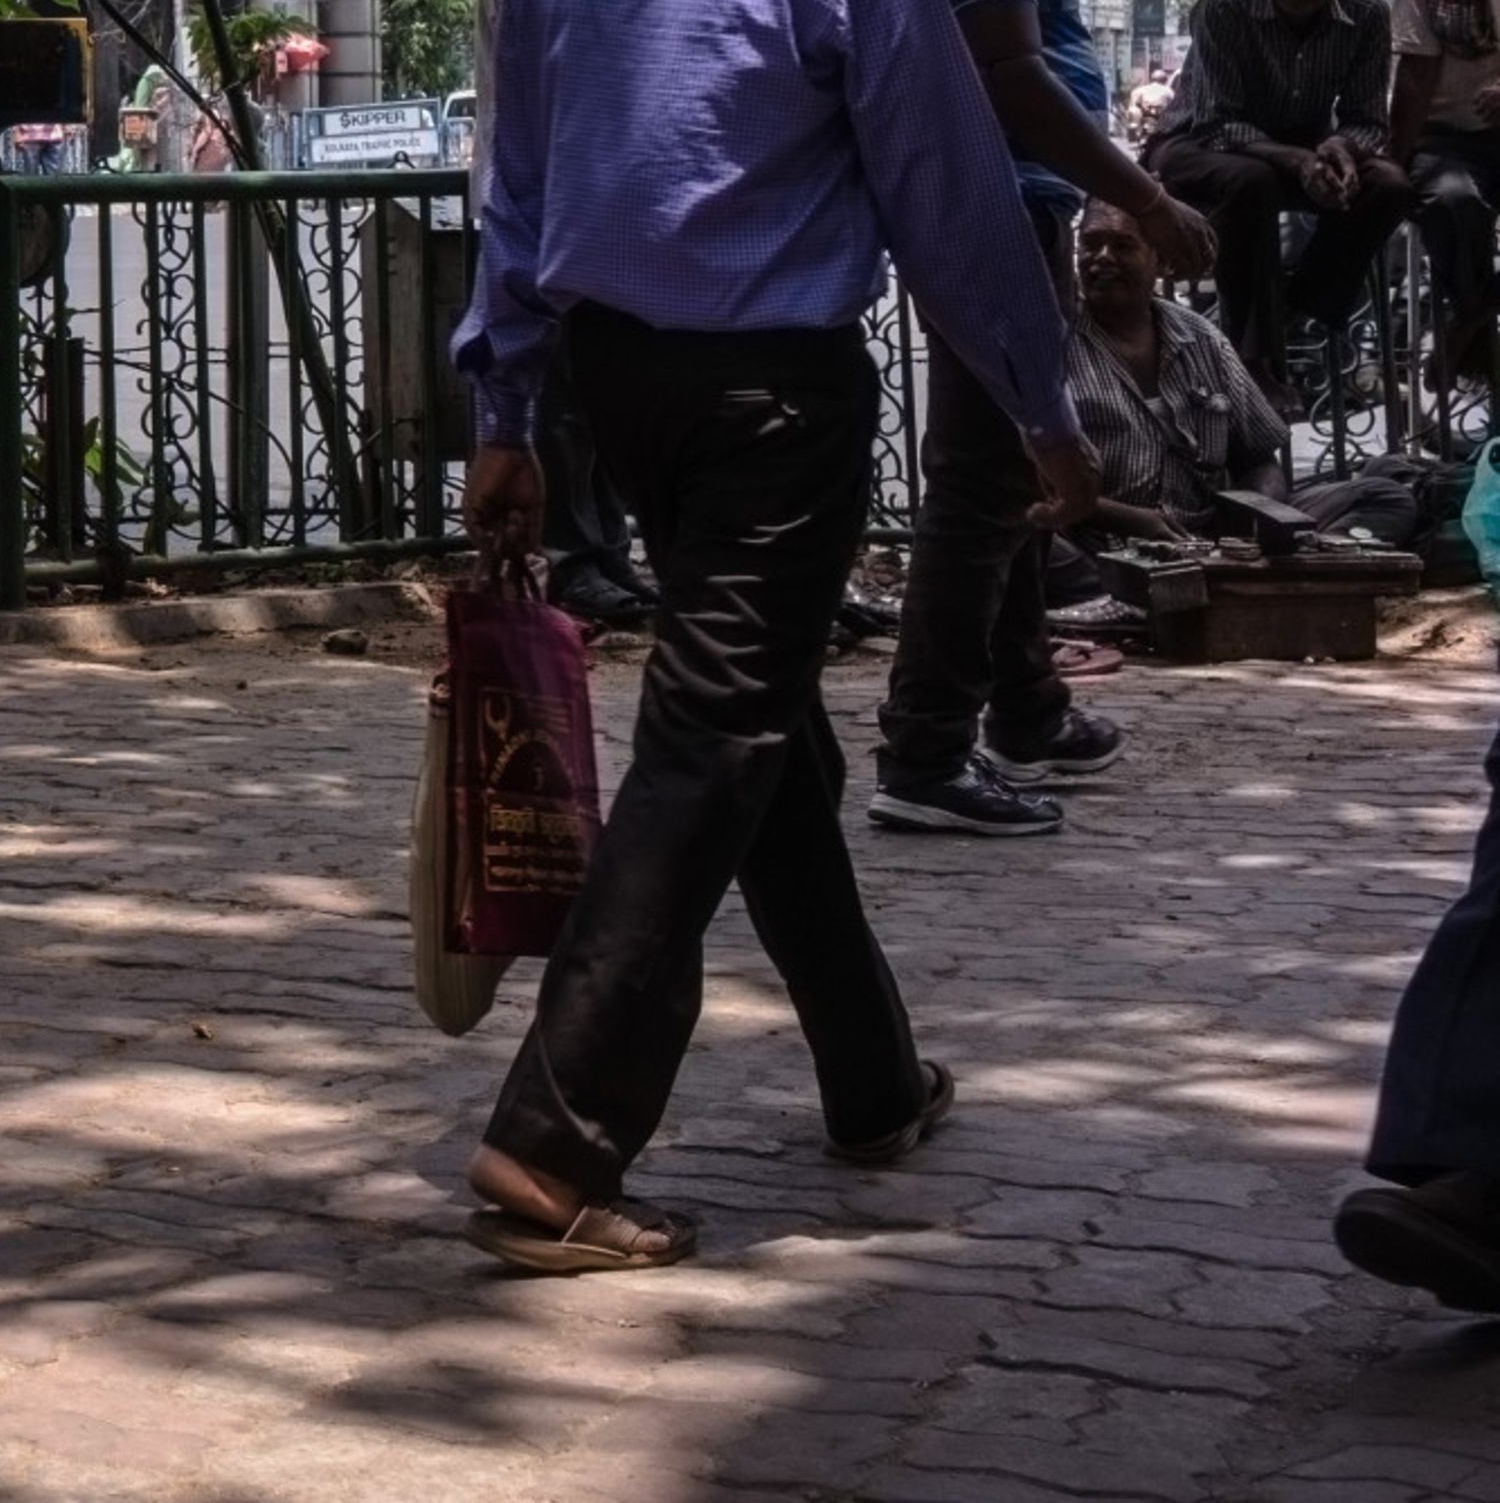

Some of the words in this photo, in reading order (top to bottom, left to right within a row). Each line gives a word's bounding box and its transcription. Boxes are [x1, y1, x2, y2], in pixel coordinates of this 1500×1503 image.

[340, 109, 406, 129] SKIPPER
[324, 142, 360, 153] KOLKATA
[360, 139, 392, 150] TRAFFIC
[393, 136, 422, 148] POLICE
